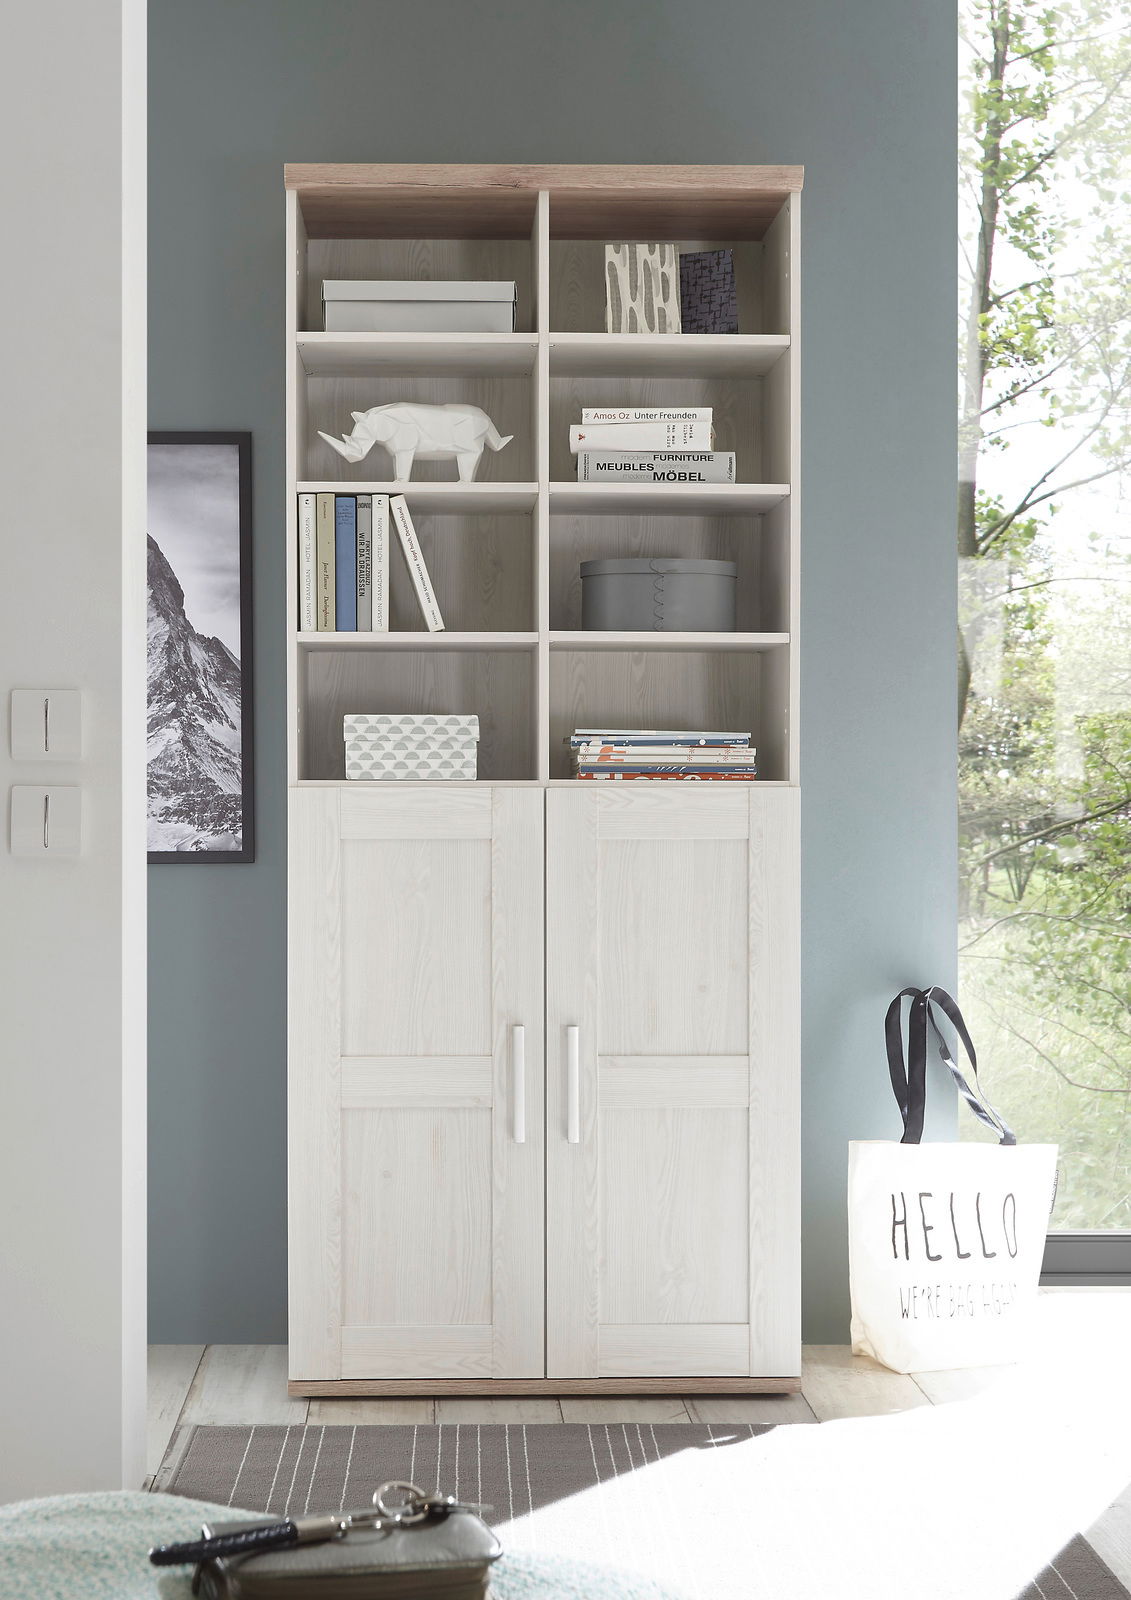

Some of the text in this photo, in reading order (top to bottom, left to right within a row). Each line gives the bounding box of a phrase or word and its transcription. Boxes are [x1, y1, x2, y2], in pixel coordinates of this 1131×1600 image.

[592, 412, 698, 420] Amos Oz Unter Freunden
[653, 454, 714, 462] FURNITURE
[596, 462, 654, 472] MEUBLES
[652, 470, 706, 482] MÖBEL
[396, 506, 410, 536] Deutschland
[358, 548, 366, 558] DA
[410, 549, 418, 561] Kopf
[891, 1191, 1018, 1262] HELLO
[899, 1284, 940, 1319] WE'RE
